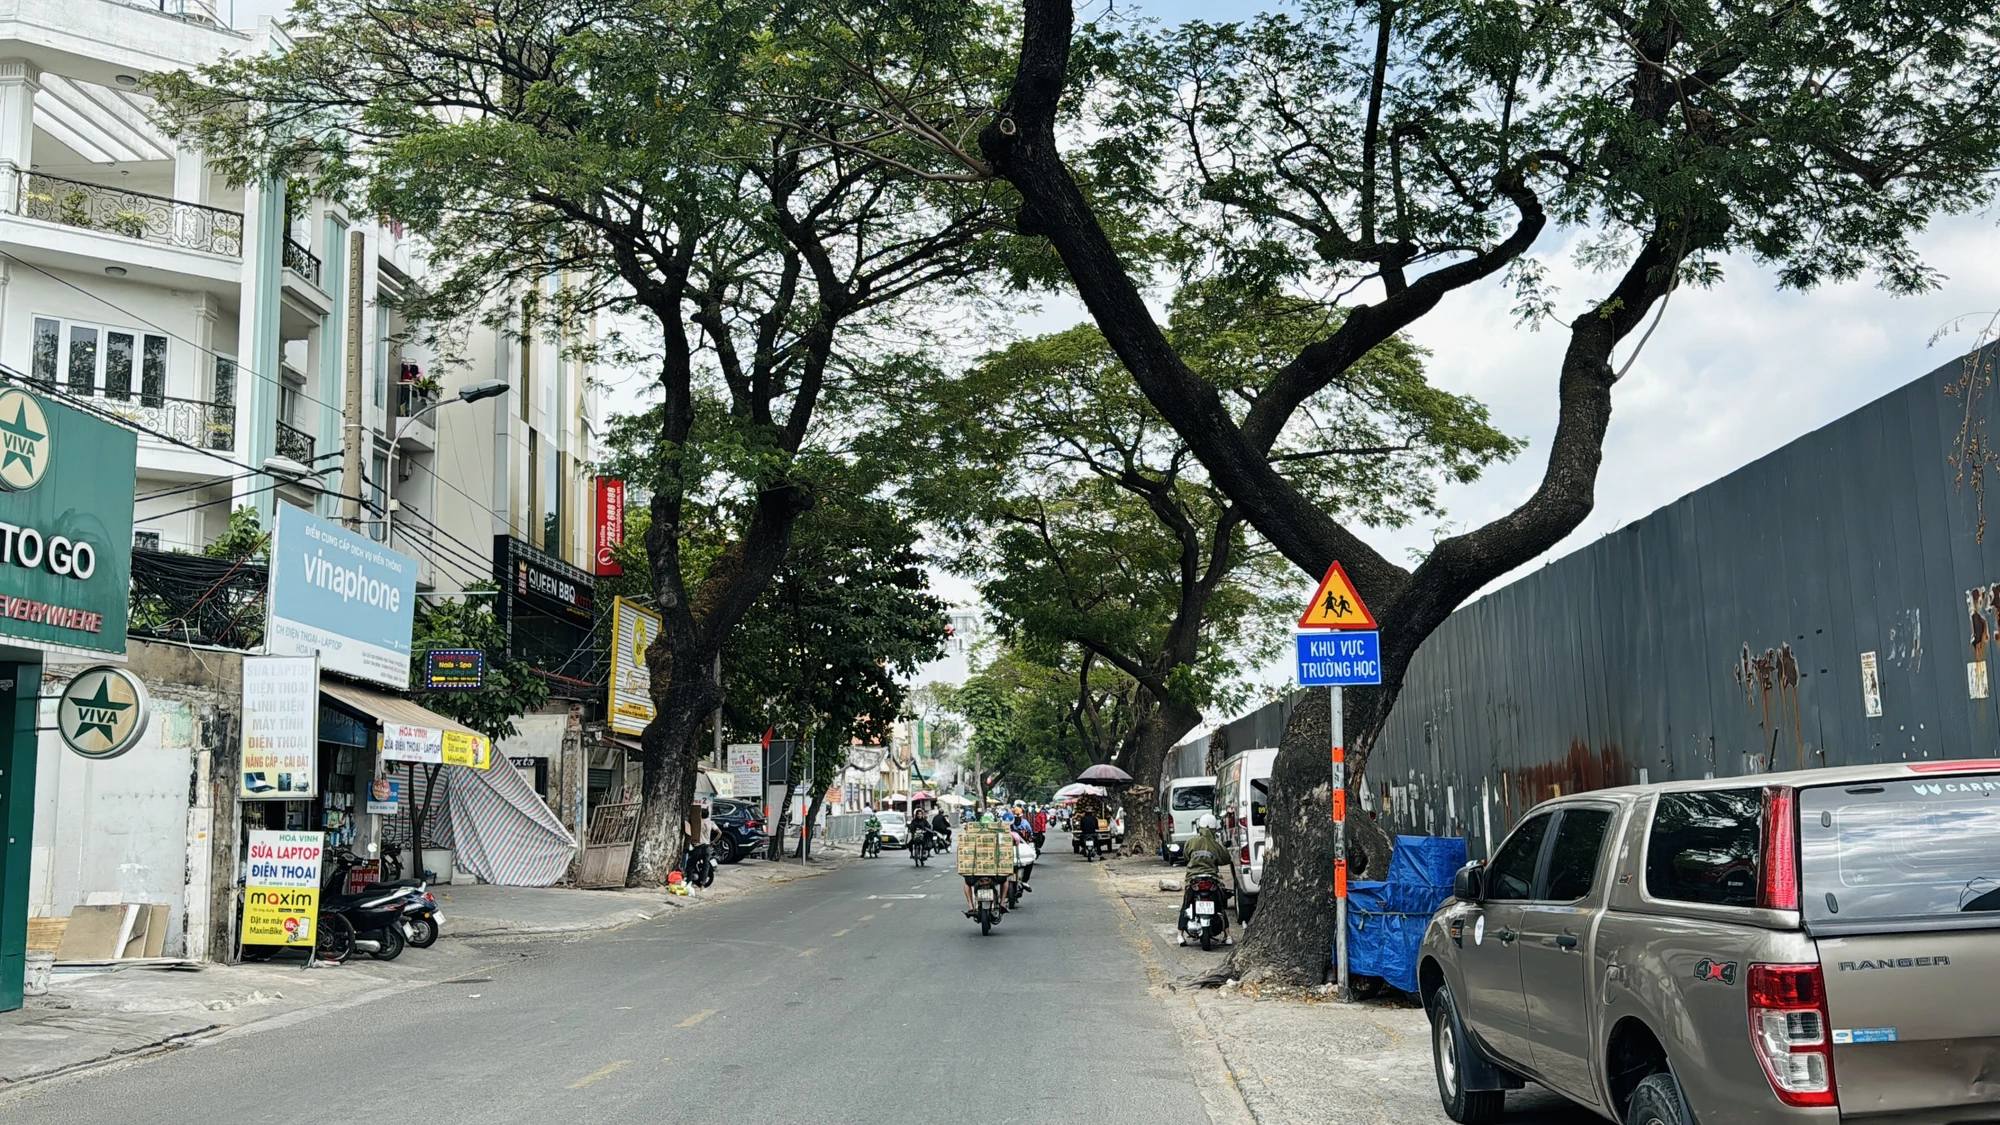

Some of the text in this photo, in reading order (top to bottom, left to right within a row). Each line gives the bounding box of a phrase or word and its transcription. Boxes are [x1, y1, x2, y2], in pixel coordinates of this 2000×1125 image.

[3, 432, 36, 458] VIVA
[321, 532, 338, 547] CUNG
[0, 522, 95, 580] TO GO
[303, 549, 400, 613] vinaphone
[529, 568, 557, 596] QUEEN
[559, 581, 576, 605] BBQ
[275, 624, 285, 635] CH
[286, 627, 300, 641] ĐIỆN
[300, 630, 318, 645] THOẠI
[321, 636, 343, 651] LAPTOP
[296, 643, 309, 655] HOA
[1310, 639, 1365, 658] KHU VỰC
[271, 664, 312, 677] LAPTOP
[438, 661, 454, 669] Nails
[459, 661, 473, 669] Spa
[1301, 658, 1377, 679] TRƯỜNG HỌC
[251, 697, 305, 715] LINH KIỆN
[78, 707, 118, 725] VIVA
[252, 716, 304, 731] MÁY TÍNH
[399, 726, 428, 739] HOA VINH
[248, 734, 308, 752] ĐIỆN THOẠI
[424, 743, 441, 755] LAPTOP
[284, 753, 296, 768] CÀI
[279, 834, 319, 843] HOA VINH
[251, 841, 320, 860] SỬA LAPTOP
[251, 861, 316, 883] ĐIỆN THOẠI
[250, 889, 312, 906] maxim
[250, 915, 262, 925] Đặt
[271, 916, 283, 926] máy
[249, 926, 283, 936] MaximBike
[1838, 955, 1950, 971] RANGER
